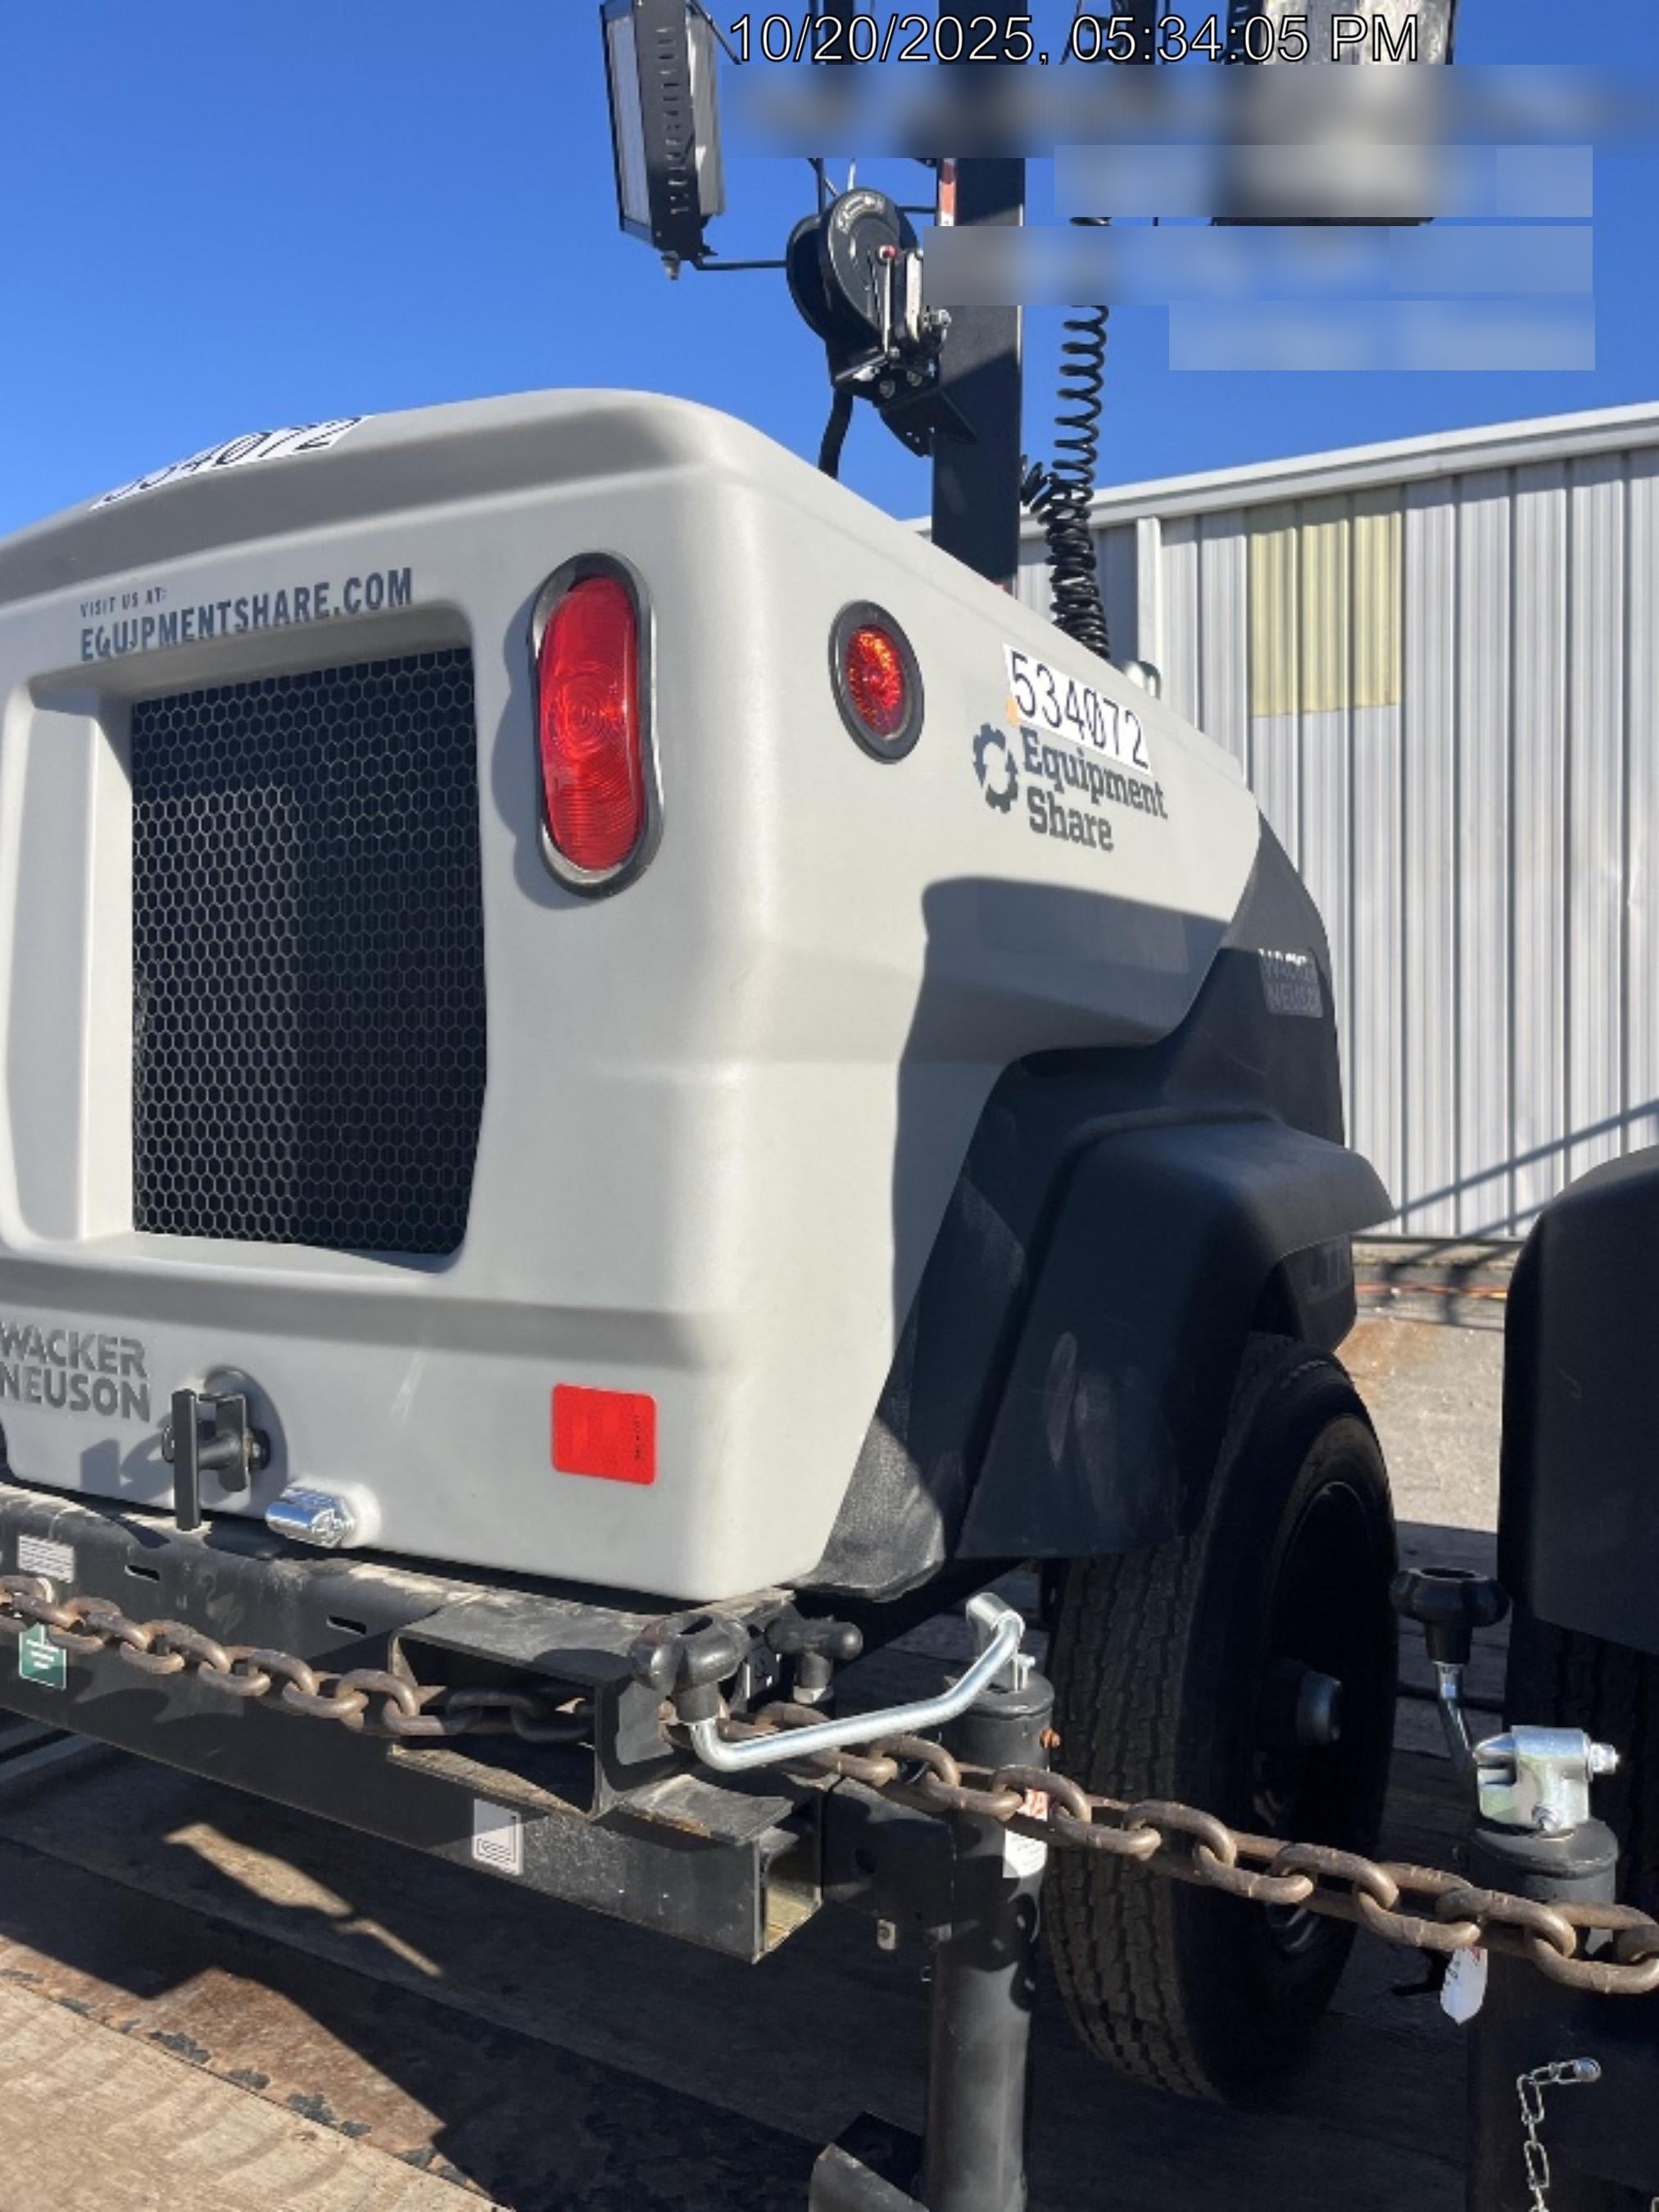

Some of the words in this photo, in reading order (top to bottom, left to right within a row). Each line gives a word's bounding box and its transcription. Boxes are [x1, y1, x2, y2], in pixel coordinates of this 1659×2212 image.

[80, 596, 116, 619] VISIT
[122, 591, 138, 610] US
[145, 586, 168, 606] AT:
[80, 567, 413, 663] EQUIPMENTSHARE.COM
[1011, 650, 1149, 770] 534072
[1020, 726, 1169, 819] Equipment
[1027, 785, 1114, 852] Share
[0, 1321, 149, 1380] WACKER
[0, 1360, 151, 1424] NEUSON
